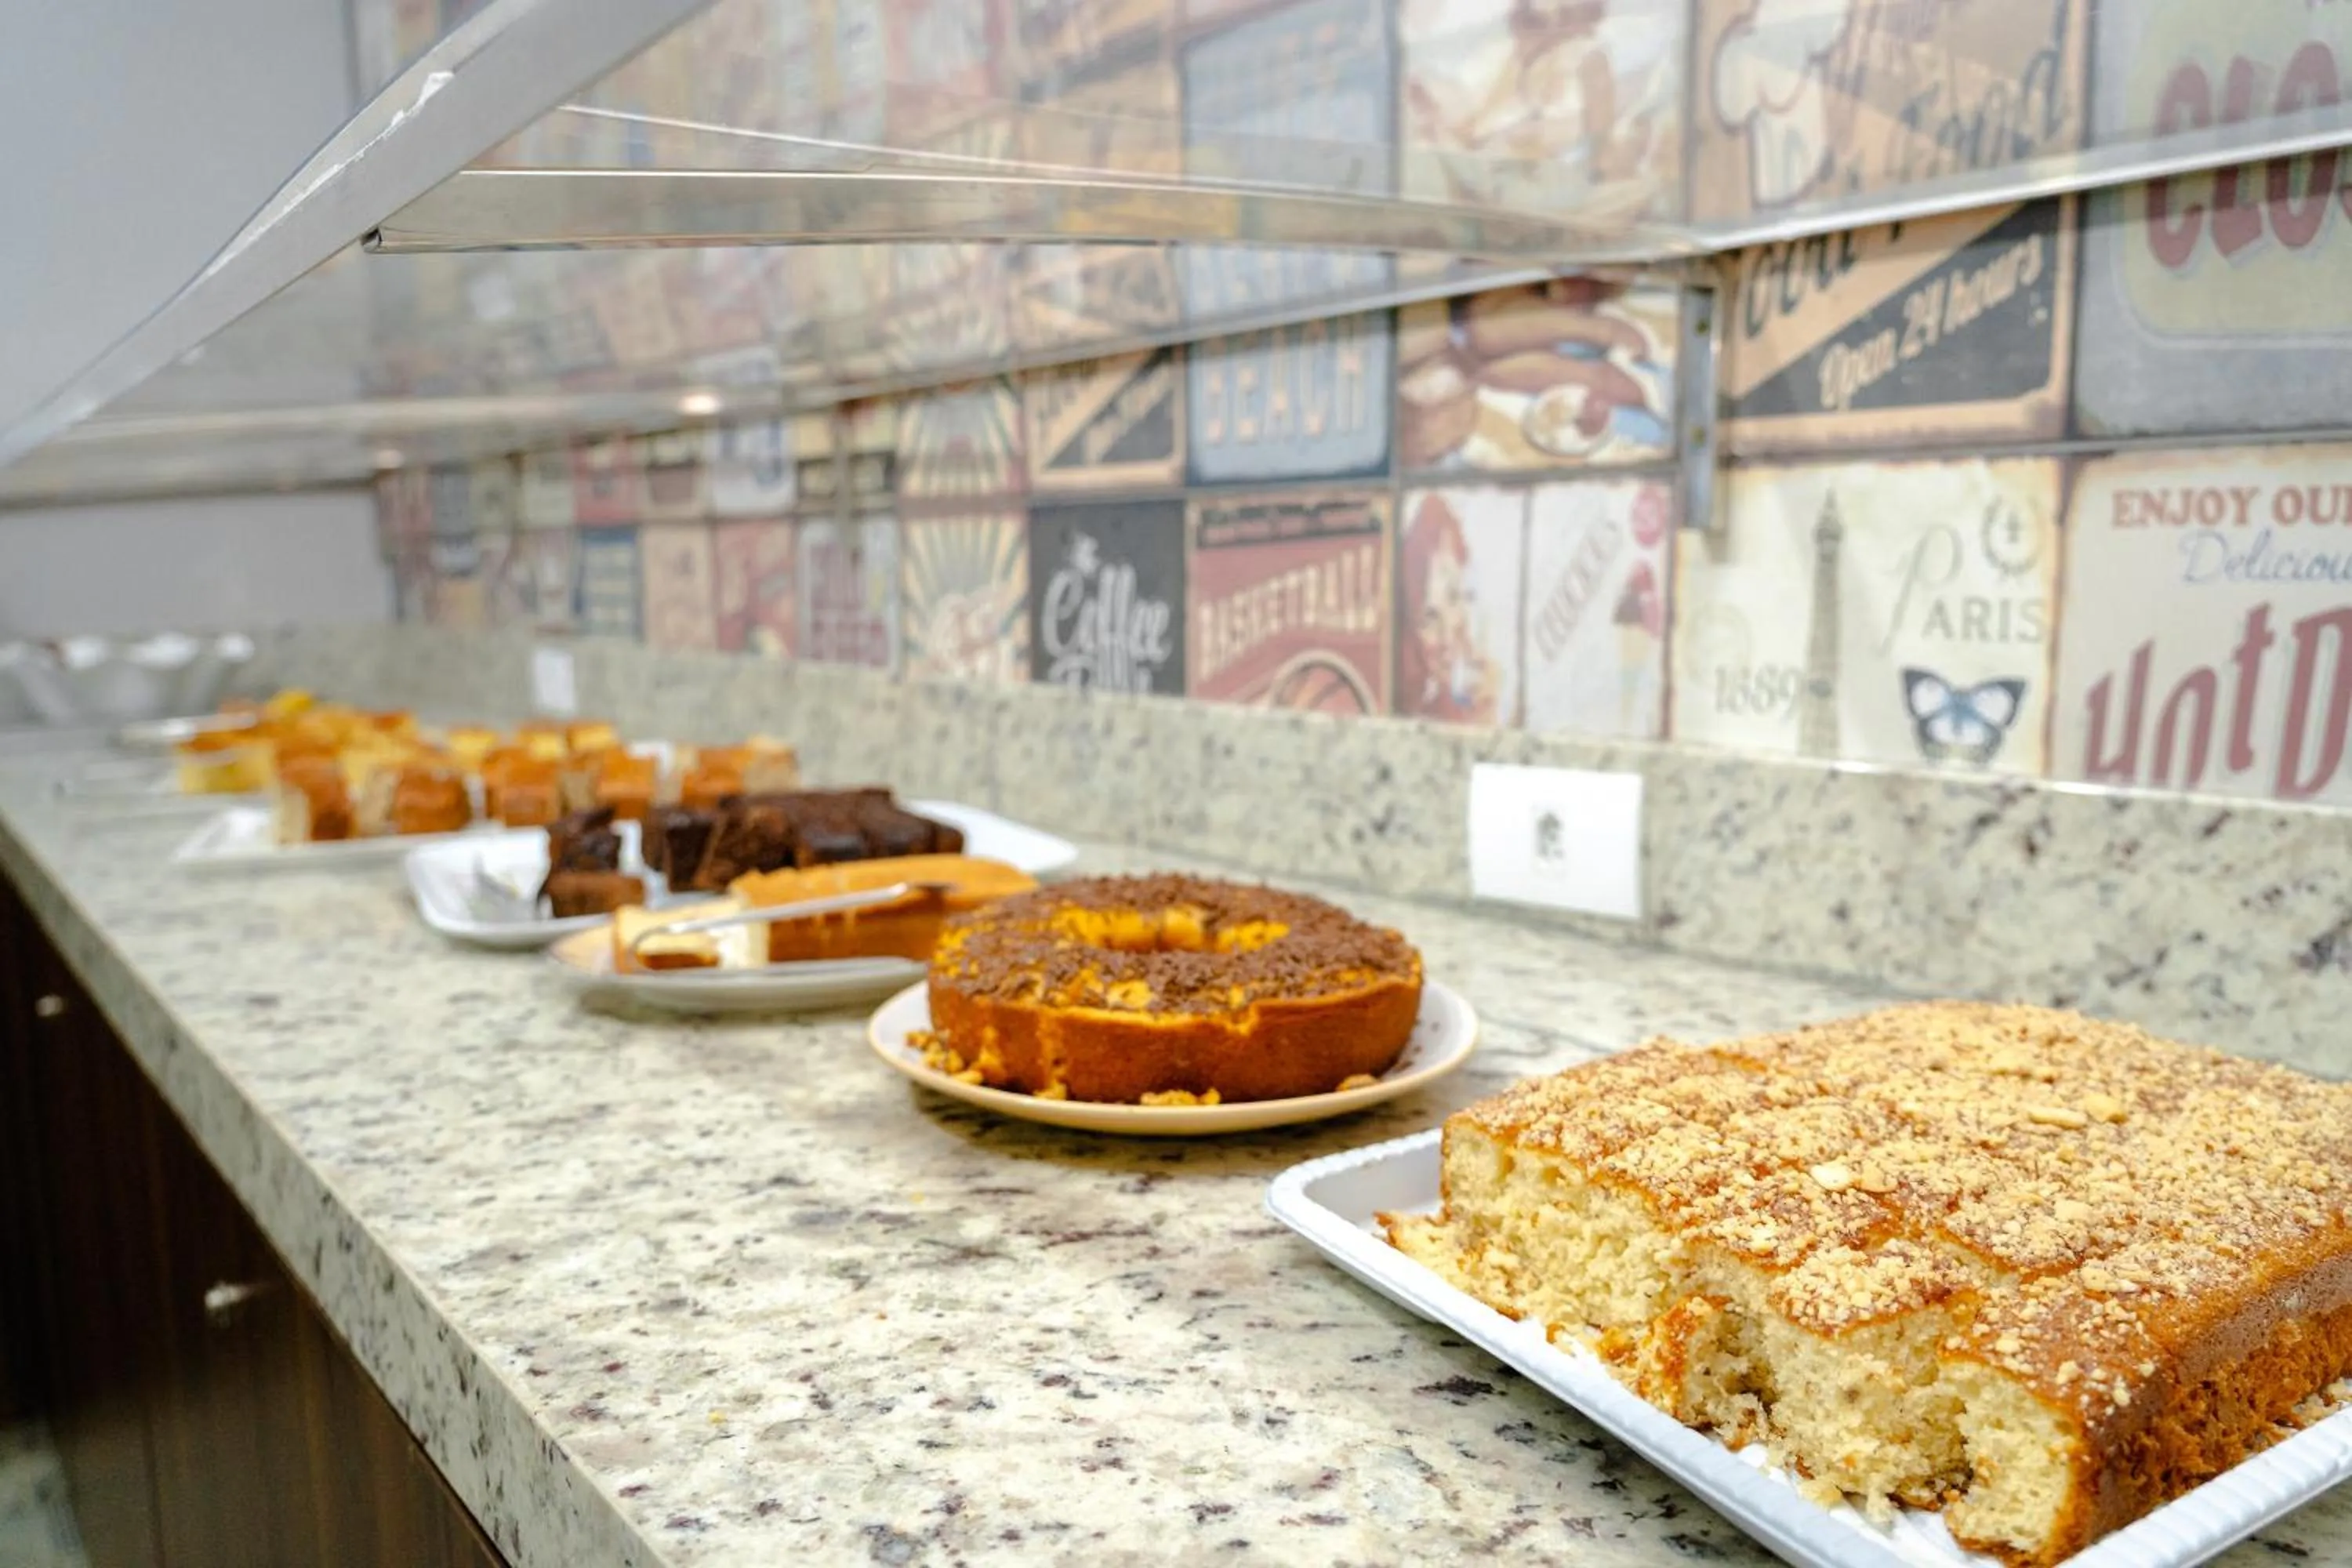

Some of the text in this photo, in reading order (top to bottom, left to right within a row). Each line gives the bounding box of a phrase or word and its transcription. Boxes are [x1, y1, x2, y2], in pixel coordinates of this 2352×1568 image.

[1818, 234, 2042, 412] Open 24 hours
[2111, 486, 2259, 529] ENJOY
[1043, 562, 1174, 681] Coffee
